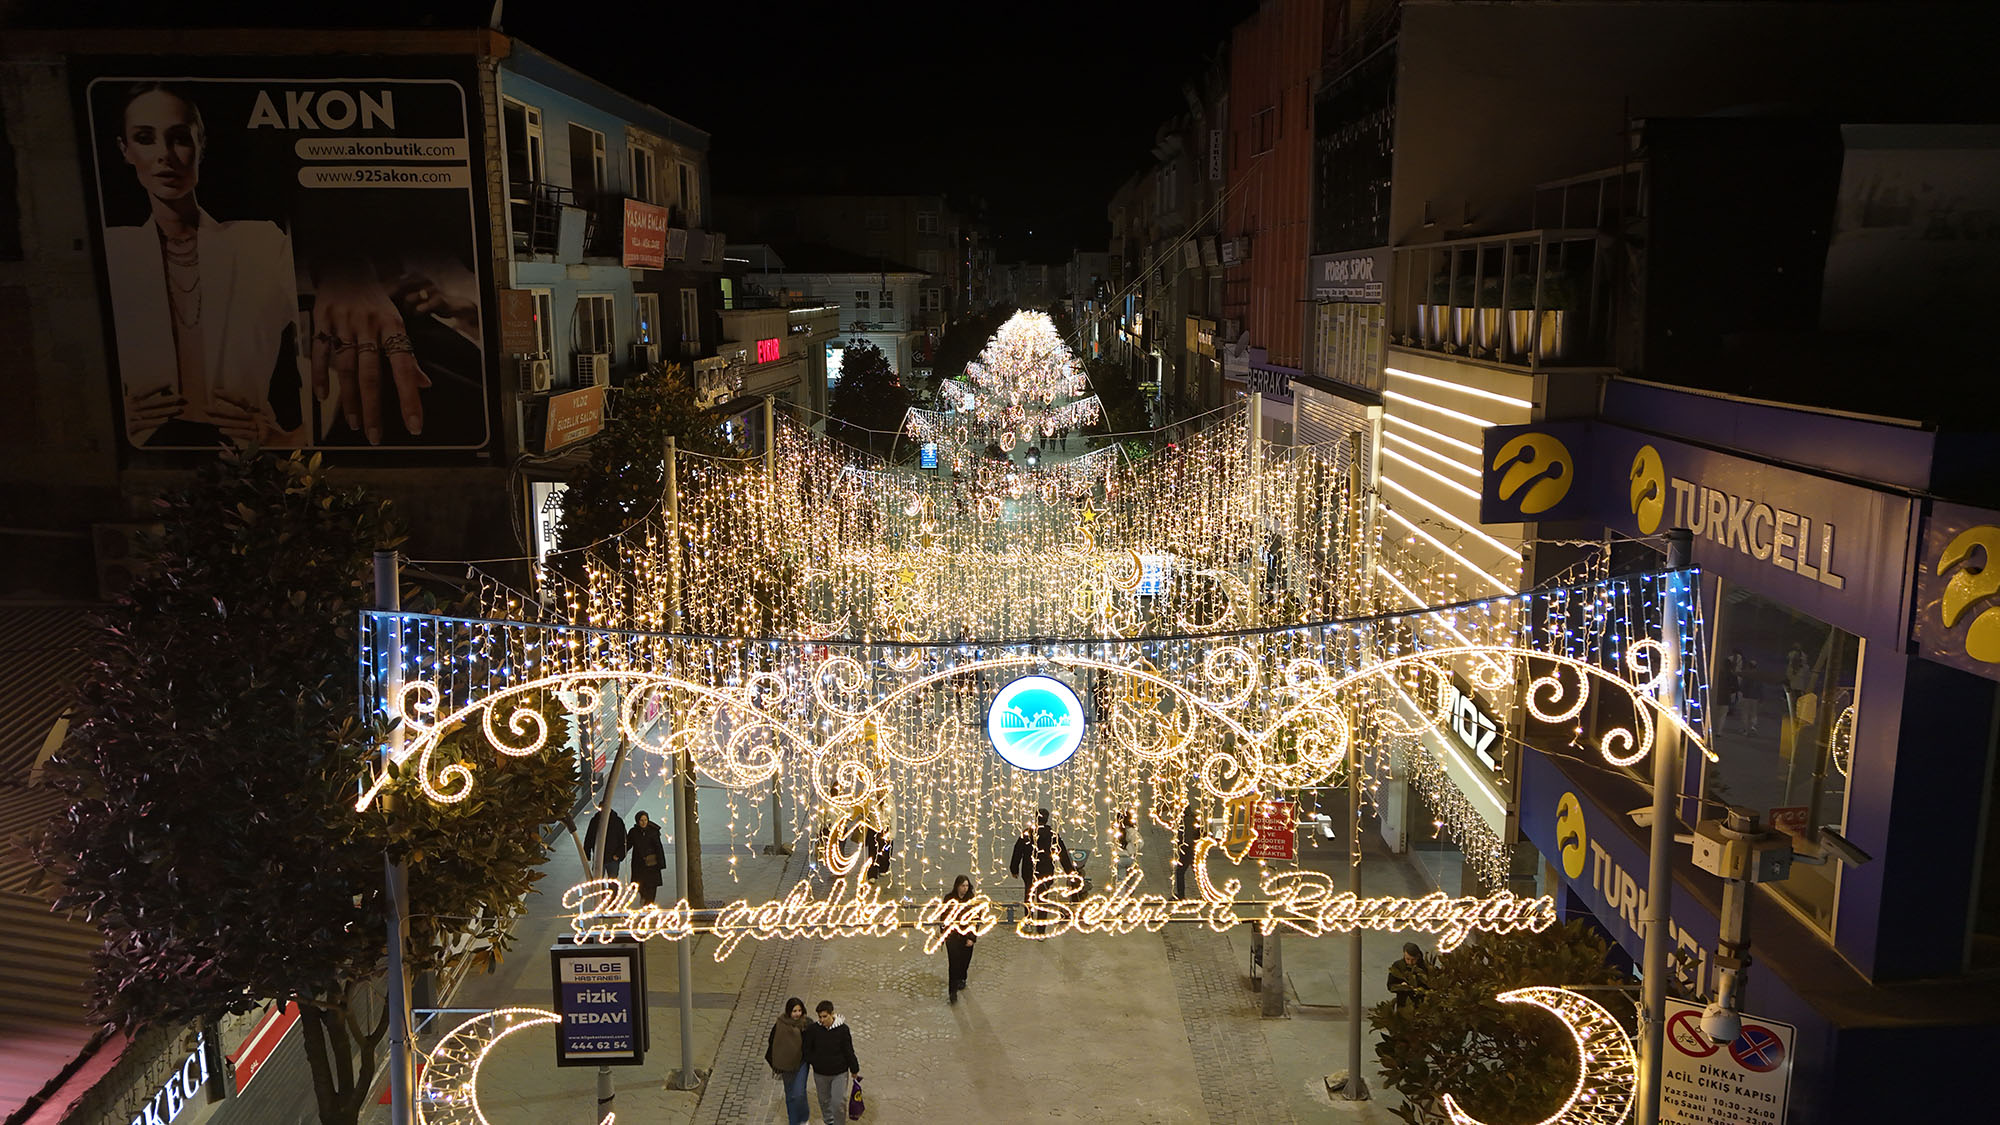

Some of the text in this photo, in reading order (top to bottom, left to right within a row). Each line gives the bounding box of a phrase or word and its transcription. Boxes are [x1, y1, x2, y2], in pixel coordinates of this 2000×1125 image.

[247, 89, 396, 131] AKON
[308, 142, 456, 157] www.akonbutik.com
[316, 169, 451, 183] www.925akon.com
[626, 210, 666, 233] YAŞAM EMLAK
[1350, 257, 1374, 281] SPOR
[1248, 368, 1282, 396] BERRAK
[1671, 477, 1845, 590] TURKCELL
[915, 894, 998, 954] ya
[1260, 871, 1556, 953] Ramazan
[1591, 838, 1708, 999] TURKEL
[577, 989, 618, 1003] FİZİK
[568, 1009, 628, 1024] TEDAVİ
[571, 1041, 628, 1050] 444 62 54
[131, 1031, 210, 1125] KECİ
[1700, 1064, 1746, 1083] DİKKAT
[1666, 1069, 1777, 1104] ACİL ÇIKIŞ KAPISI
[1678, 1109, 1704, 1122] Arası
